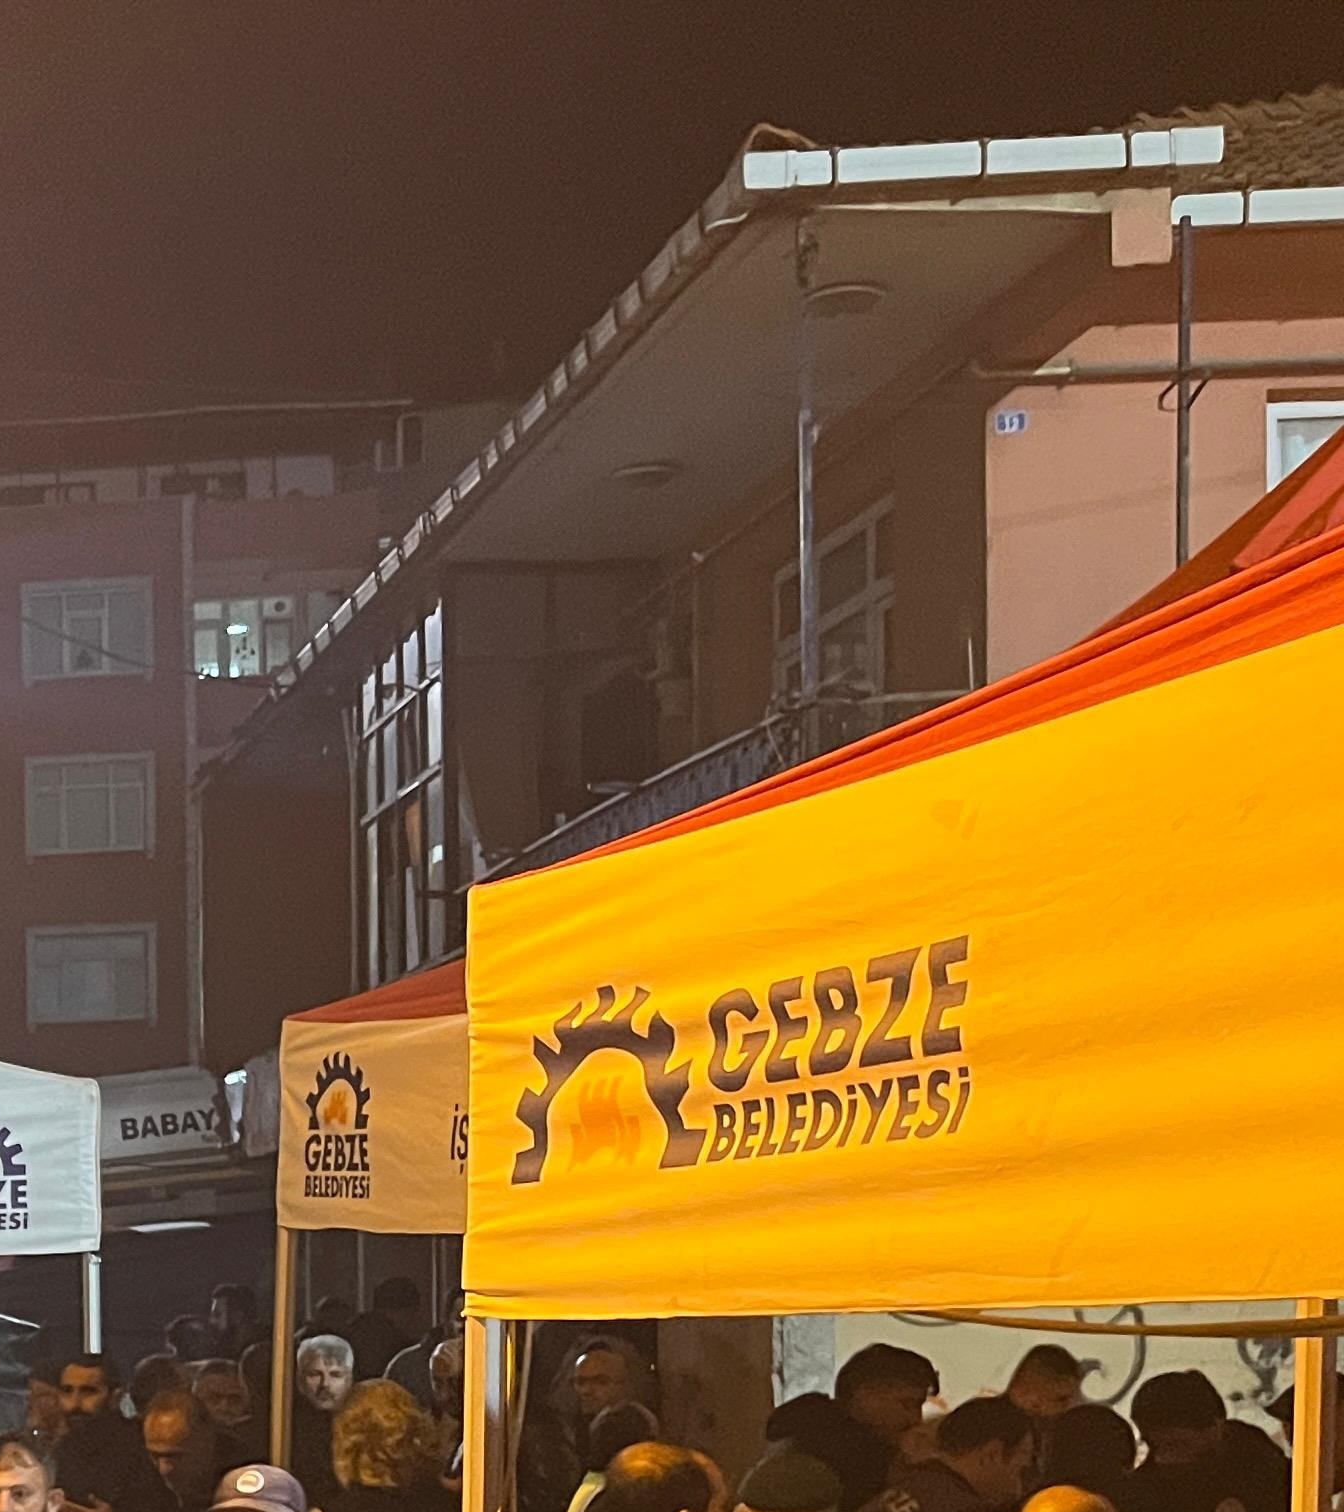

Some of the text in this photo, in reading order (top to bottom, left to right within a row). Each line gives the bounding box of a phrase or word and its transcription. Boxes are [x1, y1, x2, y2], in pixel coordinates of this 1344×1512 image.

[707, 935, 969, 1093] GEBZE
[706, 1067, 971, 1163] BELEDİYESİ
[304, 1133, 370, 1172] GEBZE
[303, 1175, 371, 1199] BELEDİYESİ
